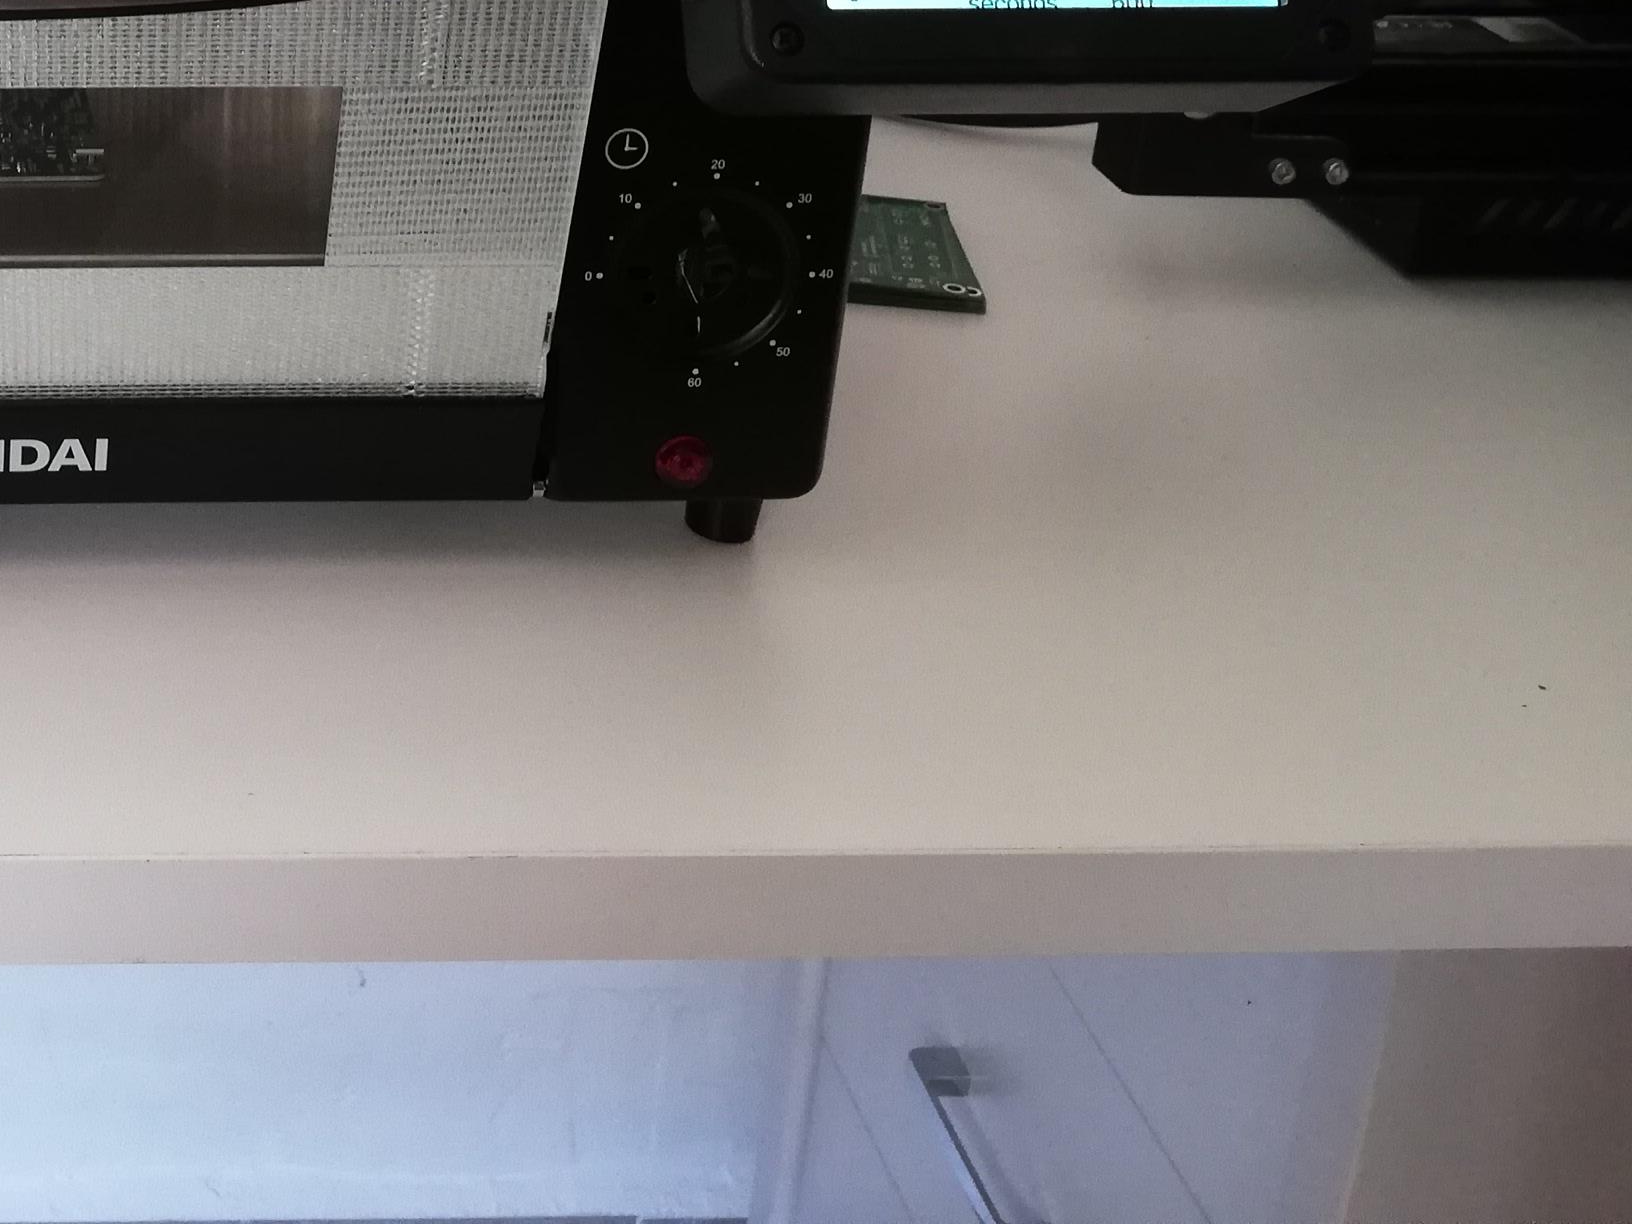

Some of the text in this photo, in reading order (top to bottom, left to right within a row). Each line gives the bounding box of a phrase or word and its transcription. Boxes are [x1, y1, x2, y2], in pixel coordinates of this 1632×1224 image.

[710, 158, 726, 170] 20
[619, 193, 633, 204] 10
[797, 192, 813, 204] 30
[584, 270, 593, 282] 0
[818, 268, 834, 280] 40
[775, 346, 791, 358] 50
[687, 377, 703, 389] 60
